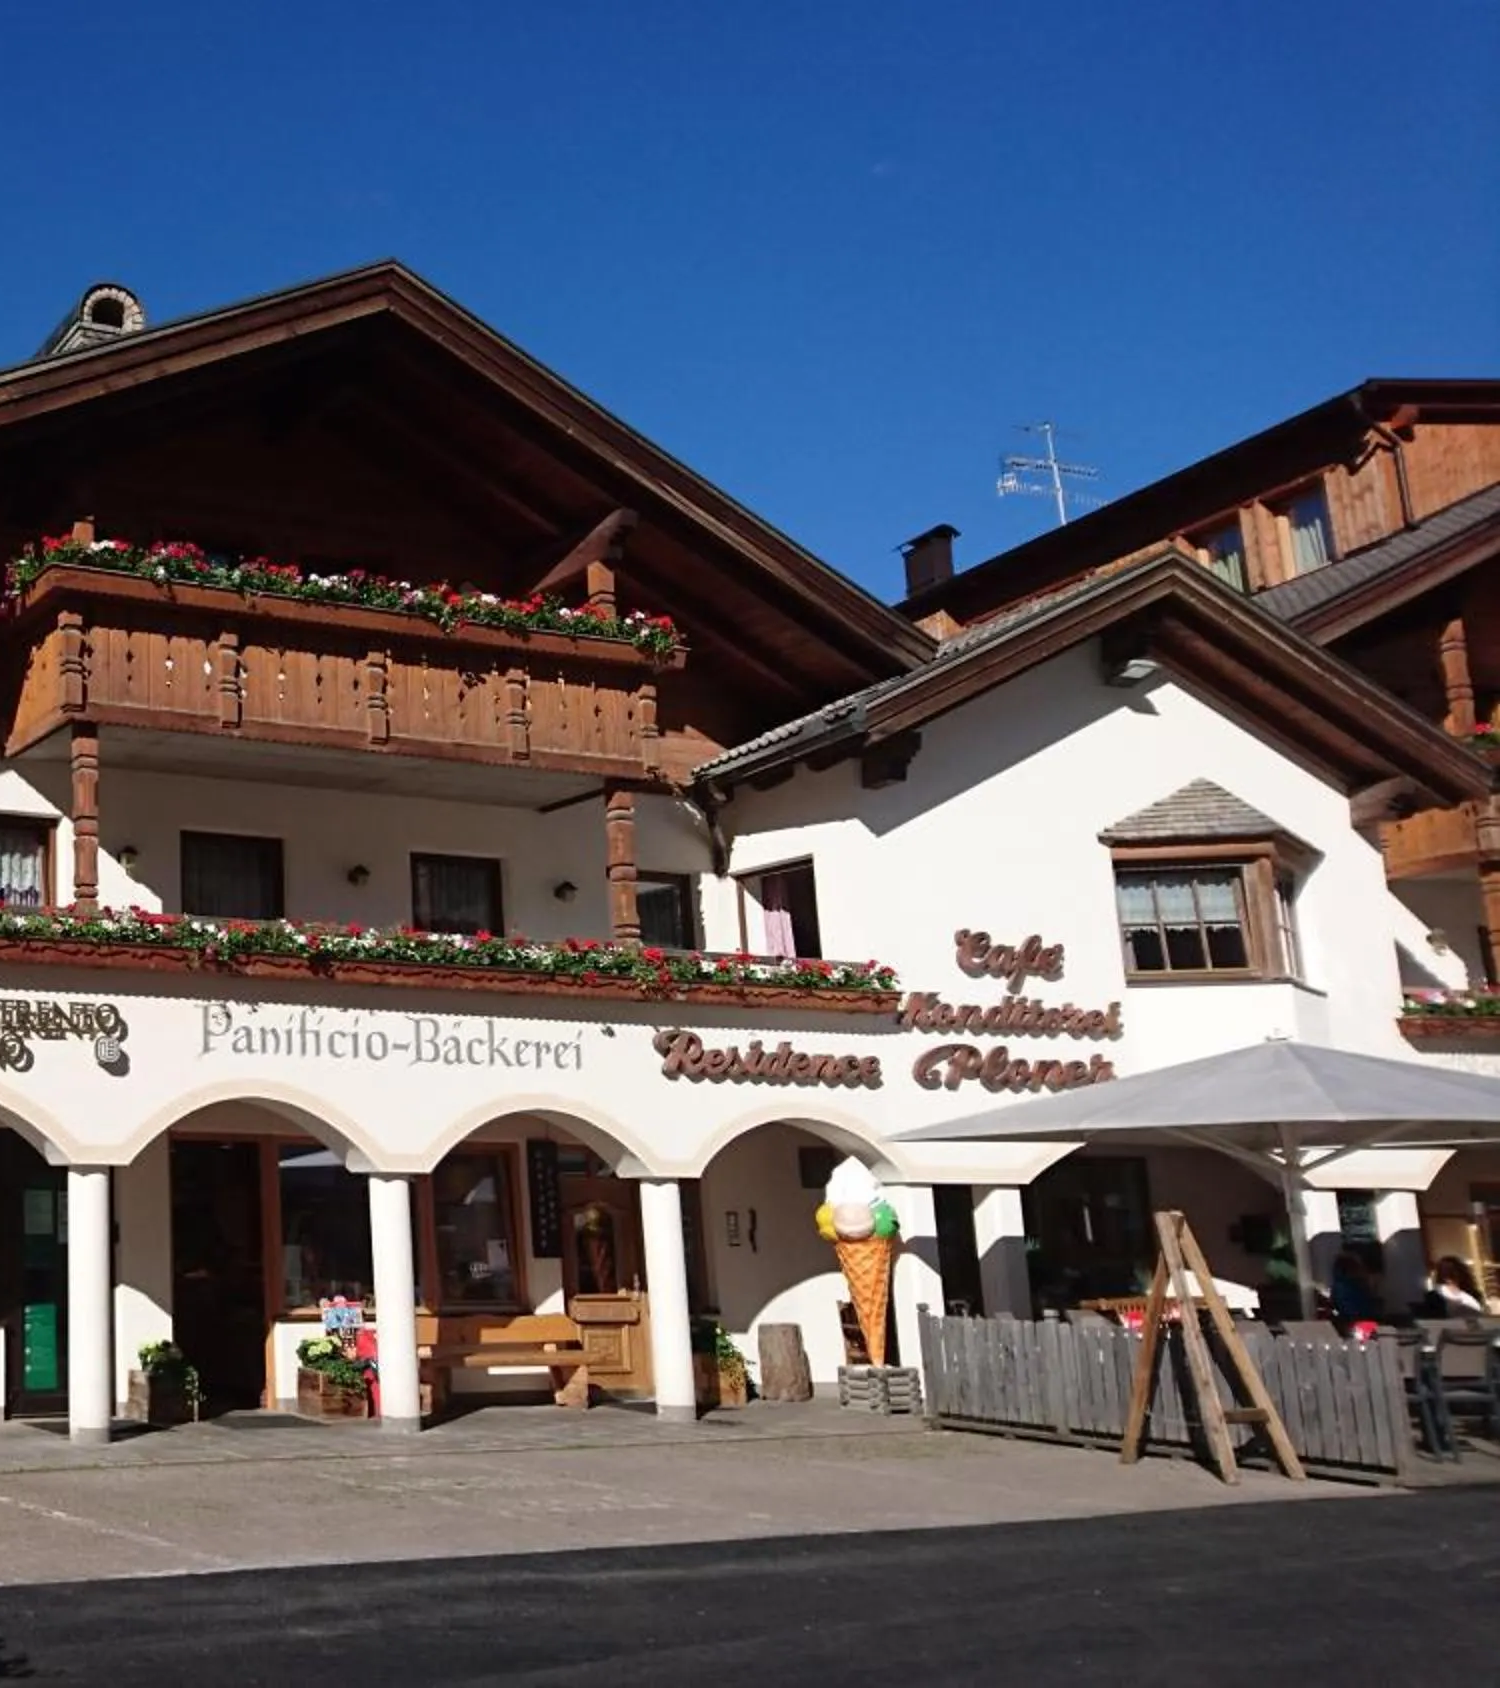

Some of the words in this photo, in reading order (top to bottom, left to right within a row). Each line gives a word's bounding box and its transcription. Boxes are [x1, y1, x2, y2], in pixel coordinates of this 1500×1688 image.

[195, 1003, 583, 1071] Panificio-Bäckerei
[902, 992, 1124, 1040] Konditorei
[653, 1029, 882, 1088] Residence
[912, 1043, 1118, 1092] Ploner
